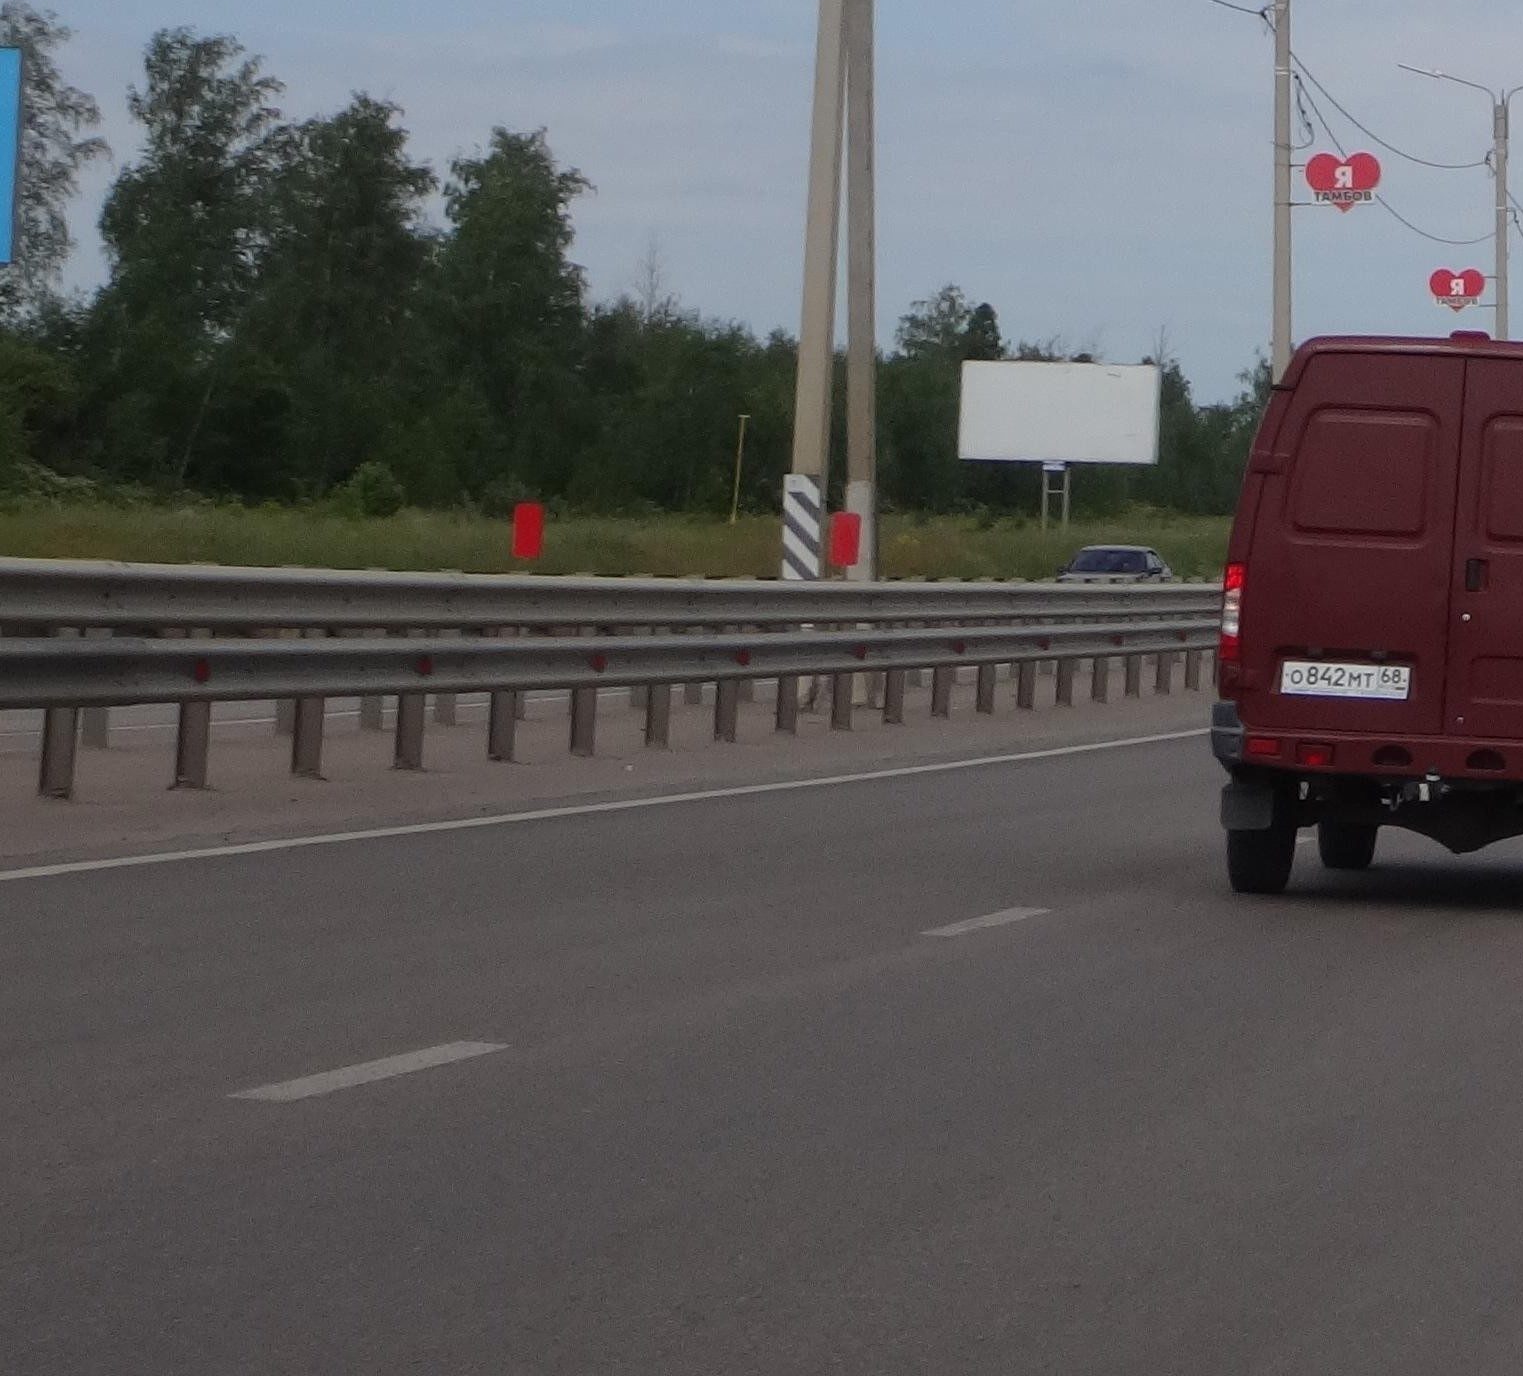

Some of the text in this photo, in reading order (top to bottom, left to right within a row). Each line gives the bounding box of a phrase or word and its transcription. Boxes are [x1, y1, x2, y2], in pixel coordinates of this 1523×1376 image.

[1334, 165, 1353, 188] Я
[1313, 190, 1373, 202] ТАМБОВ
[1450, 278, 1465, 296] Я
[1381, 668, 1401, 684] 68
